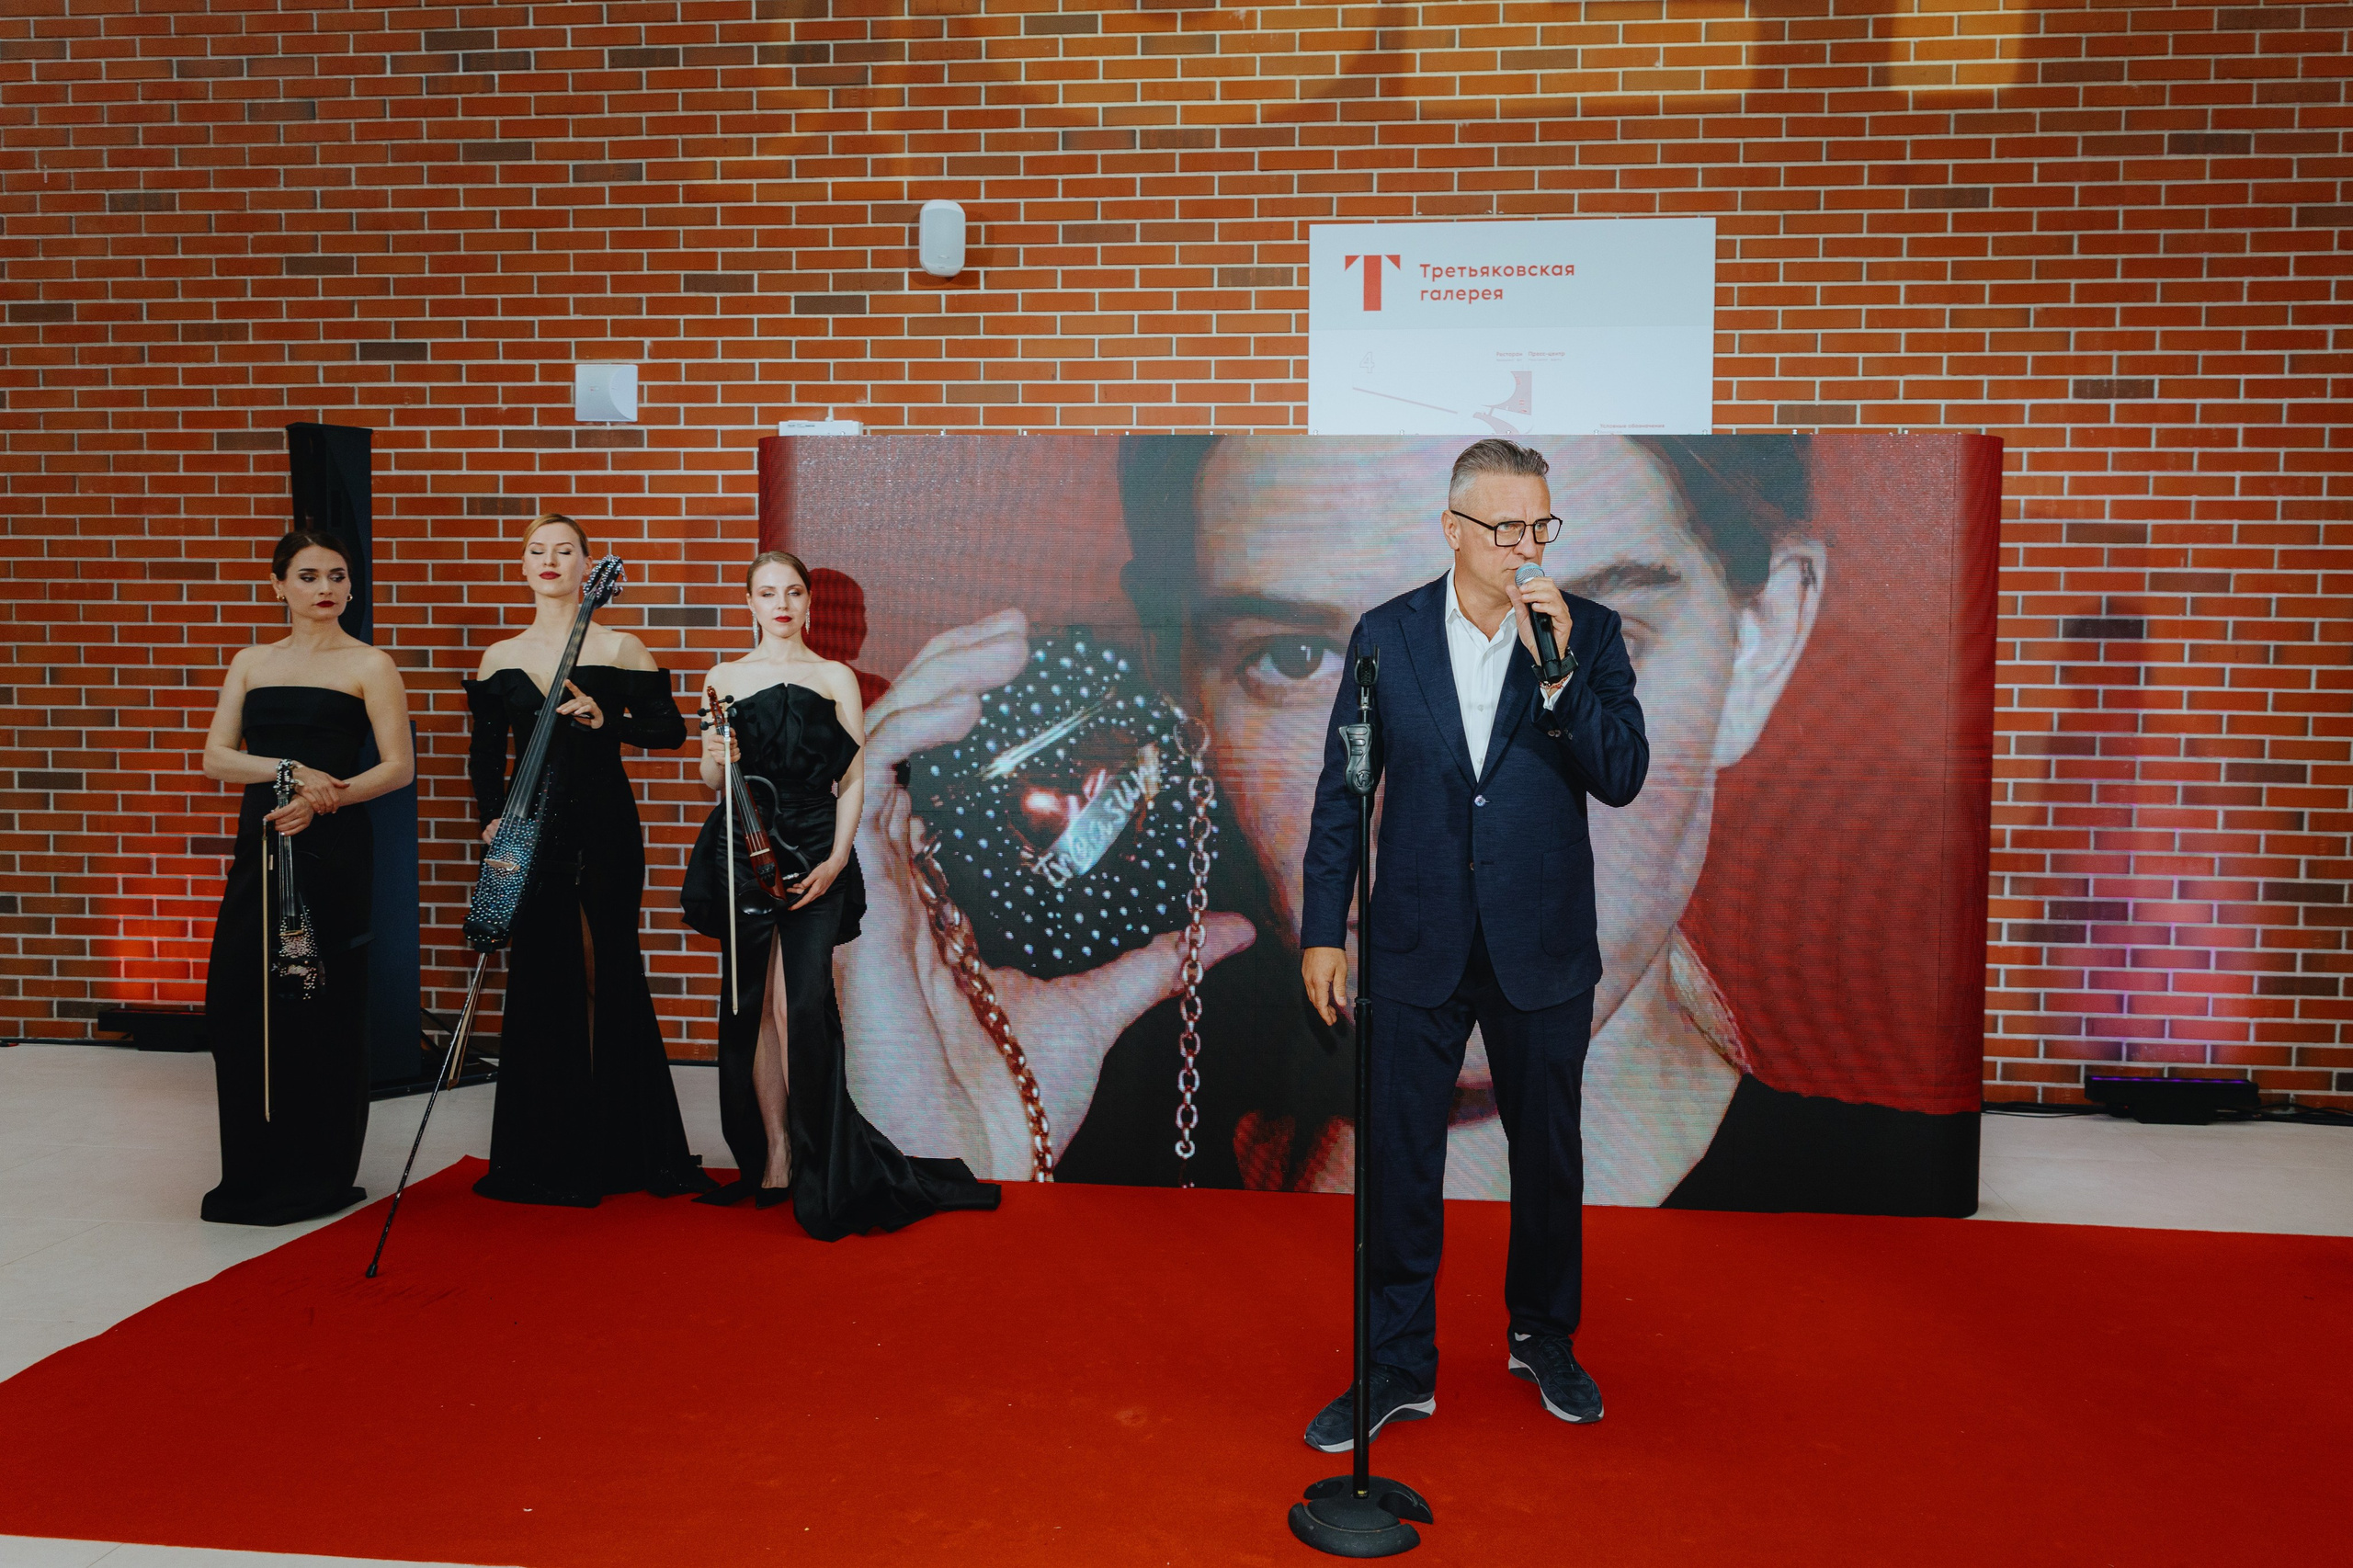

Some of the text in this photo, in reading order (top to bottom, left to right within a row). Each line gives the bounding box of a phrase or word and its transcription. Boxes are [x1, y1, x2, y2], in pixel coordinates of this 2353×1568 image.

[1419, 263, 1575, 282] Третьяковская
[1420, 288, 1504, 304] галерея
[1358, 351, 1375, 374] 4
